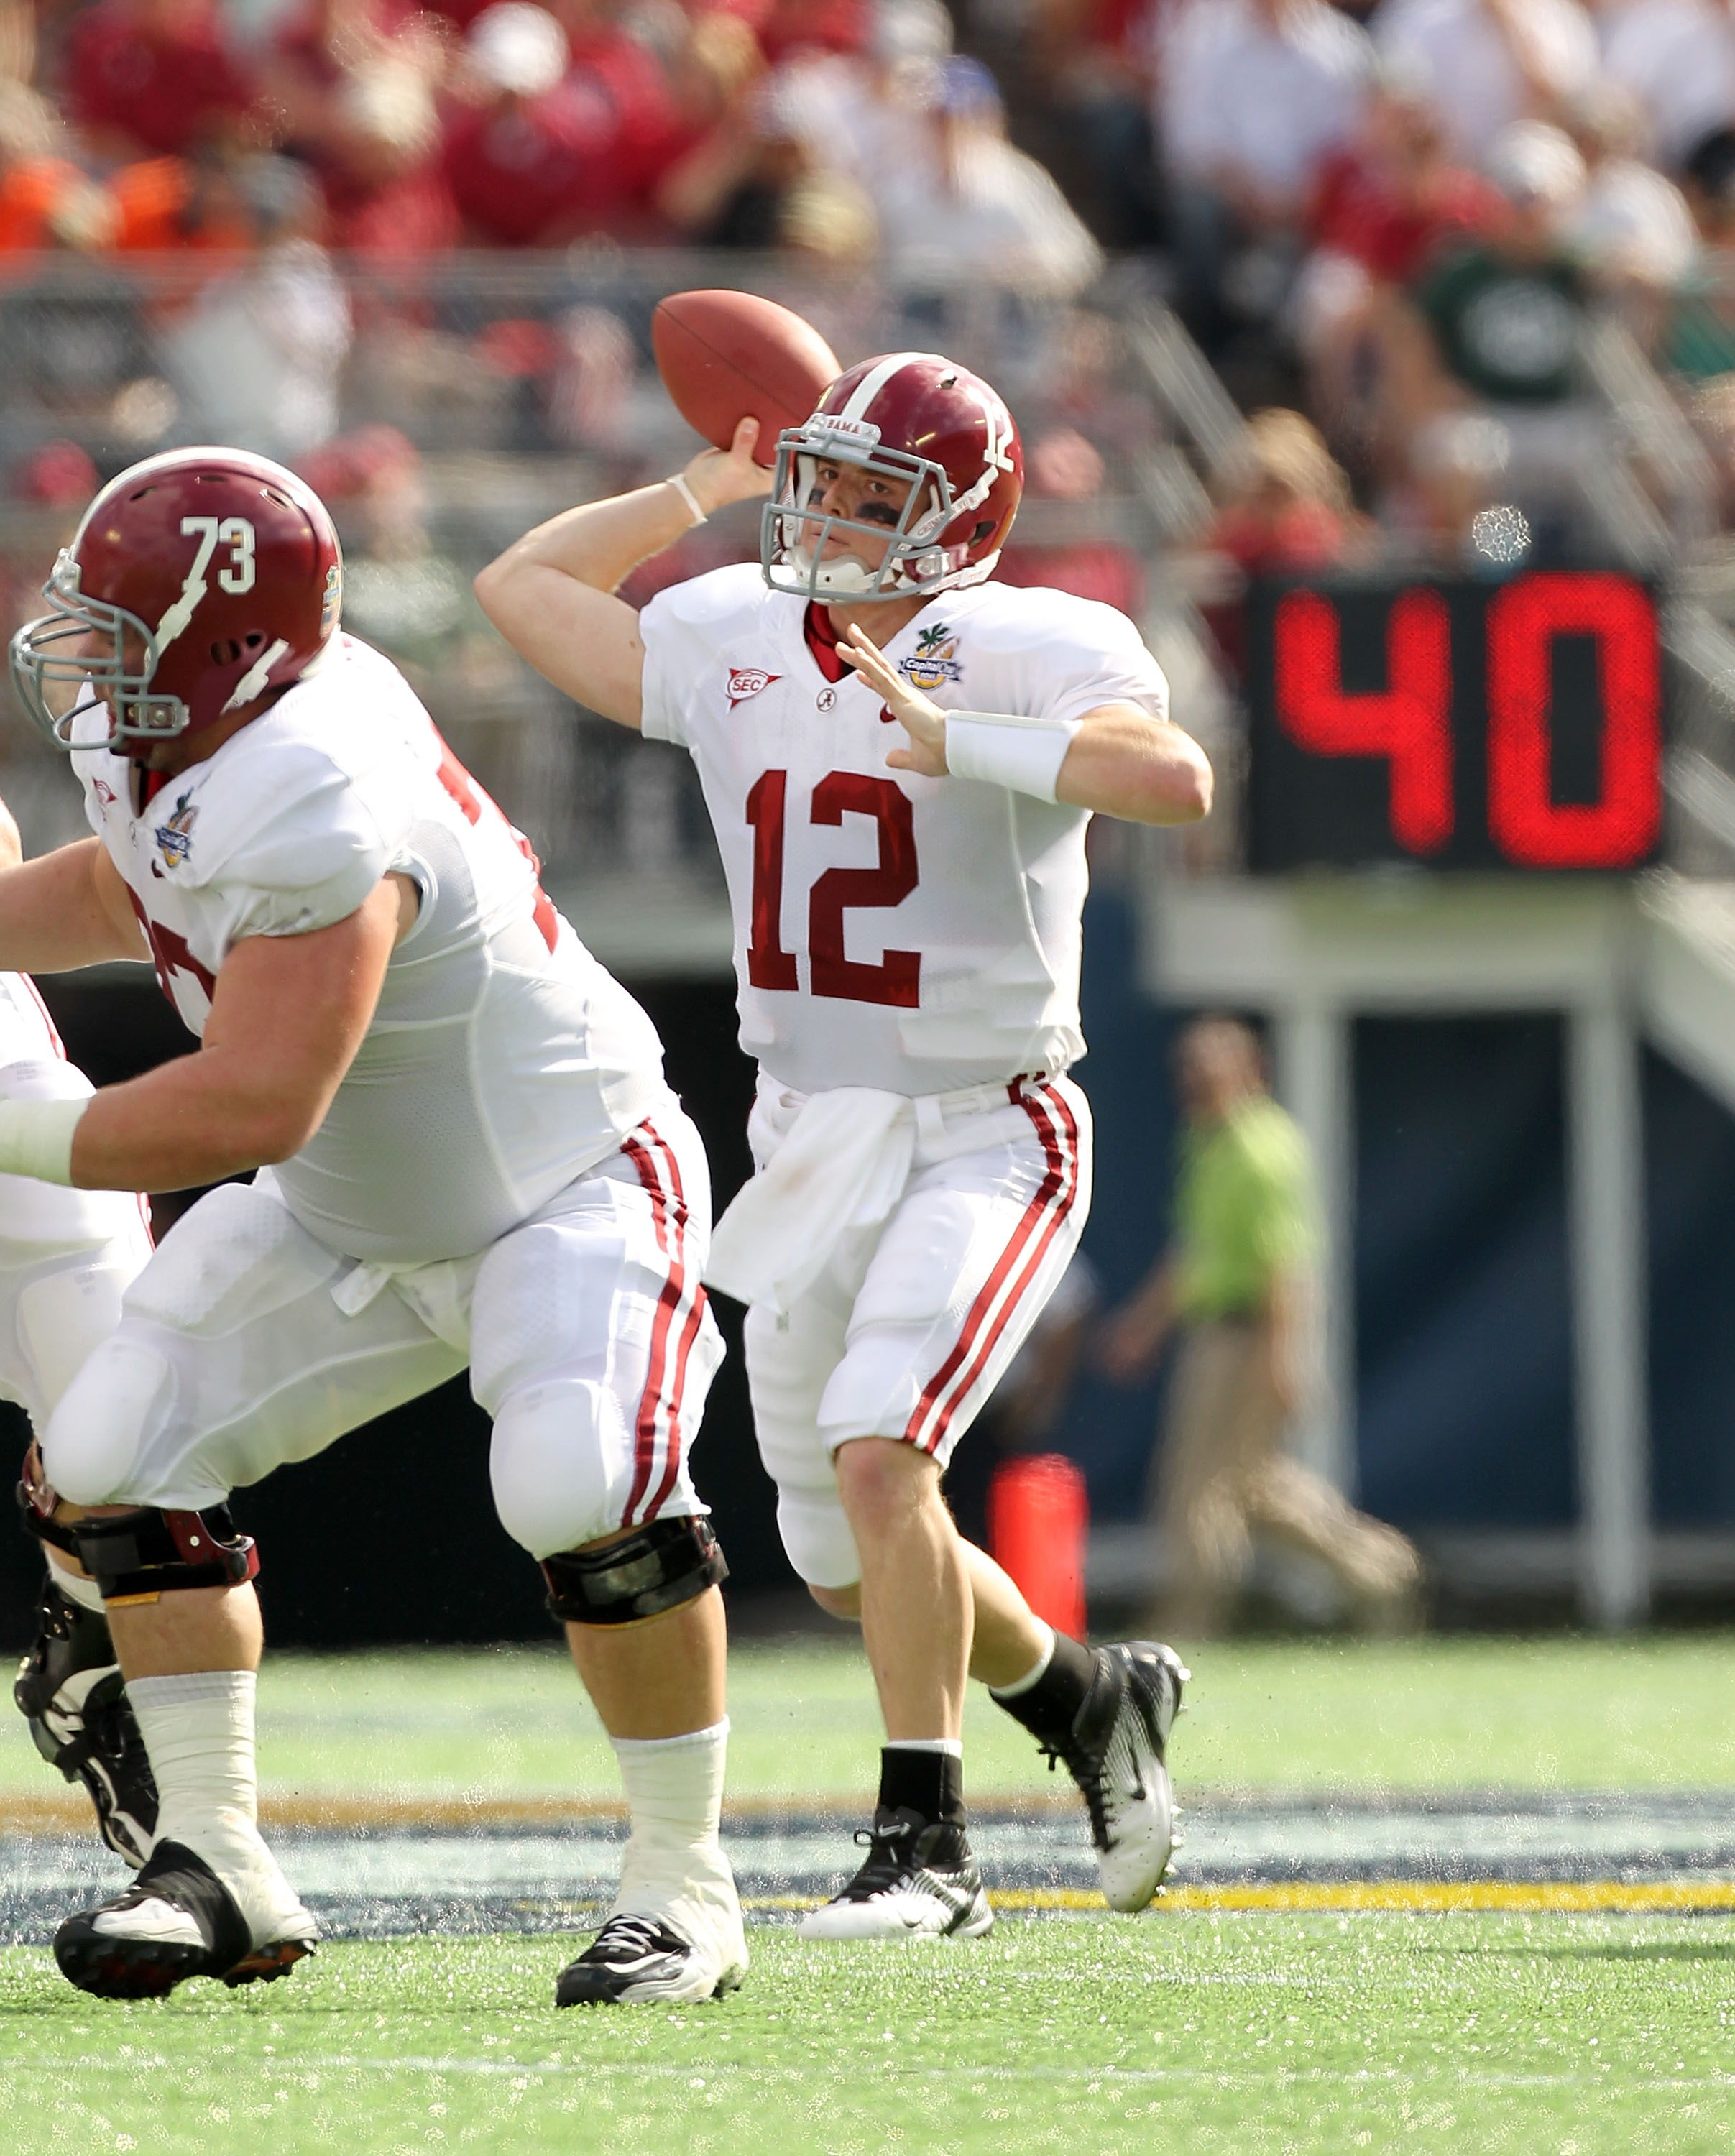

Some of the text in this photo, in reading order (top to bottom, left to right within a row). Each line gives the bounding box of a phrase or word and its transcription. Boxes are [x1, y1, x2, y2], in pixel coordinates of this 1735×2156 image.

[827, 419, 860, 435] BAMA
[982, 400, 1014, 473] 12
[180, 516, 255, 595] 73
[732, 678, 760, 691] SEC
[1274, 571, 1663, 870] 40
[746, 770, 921, 1008] 12
